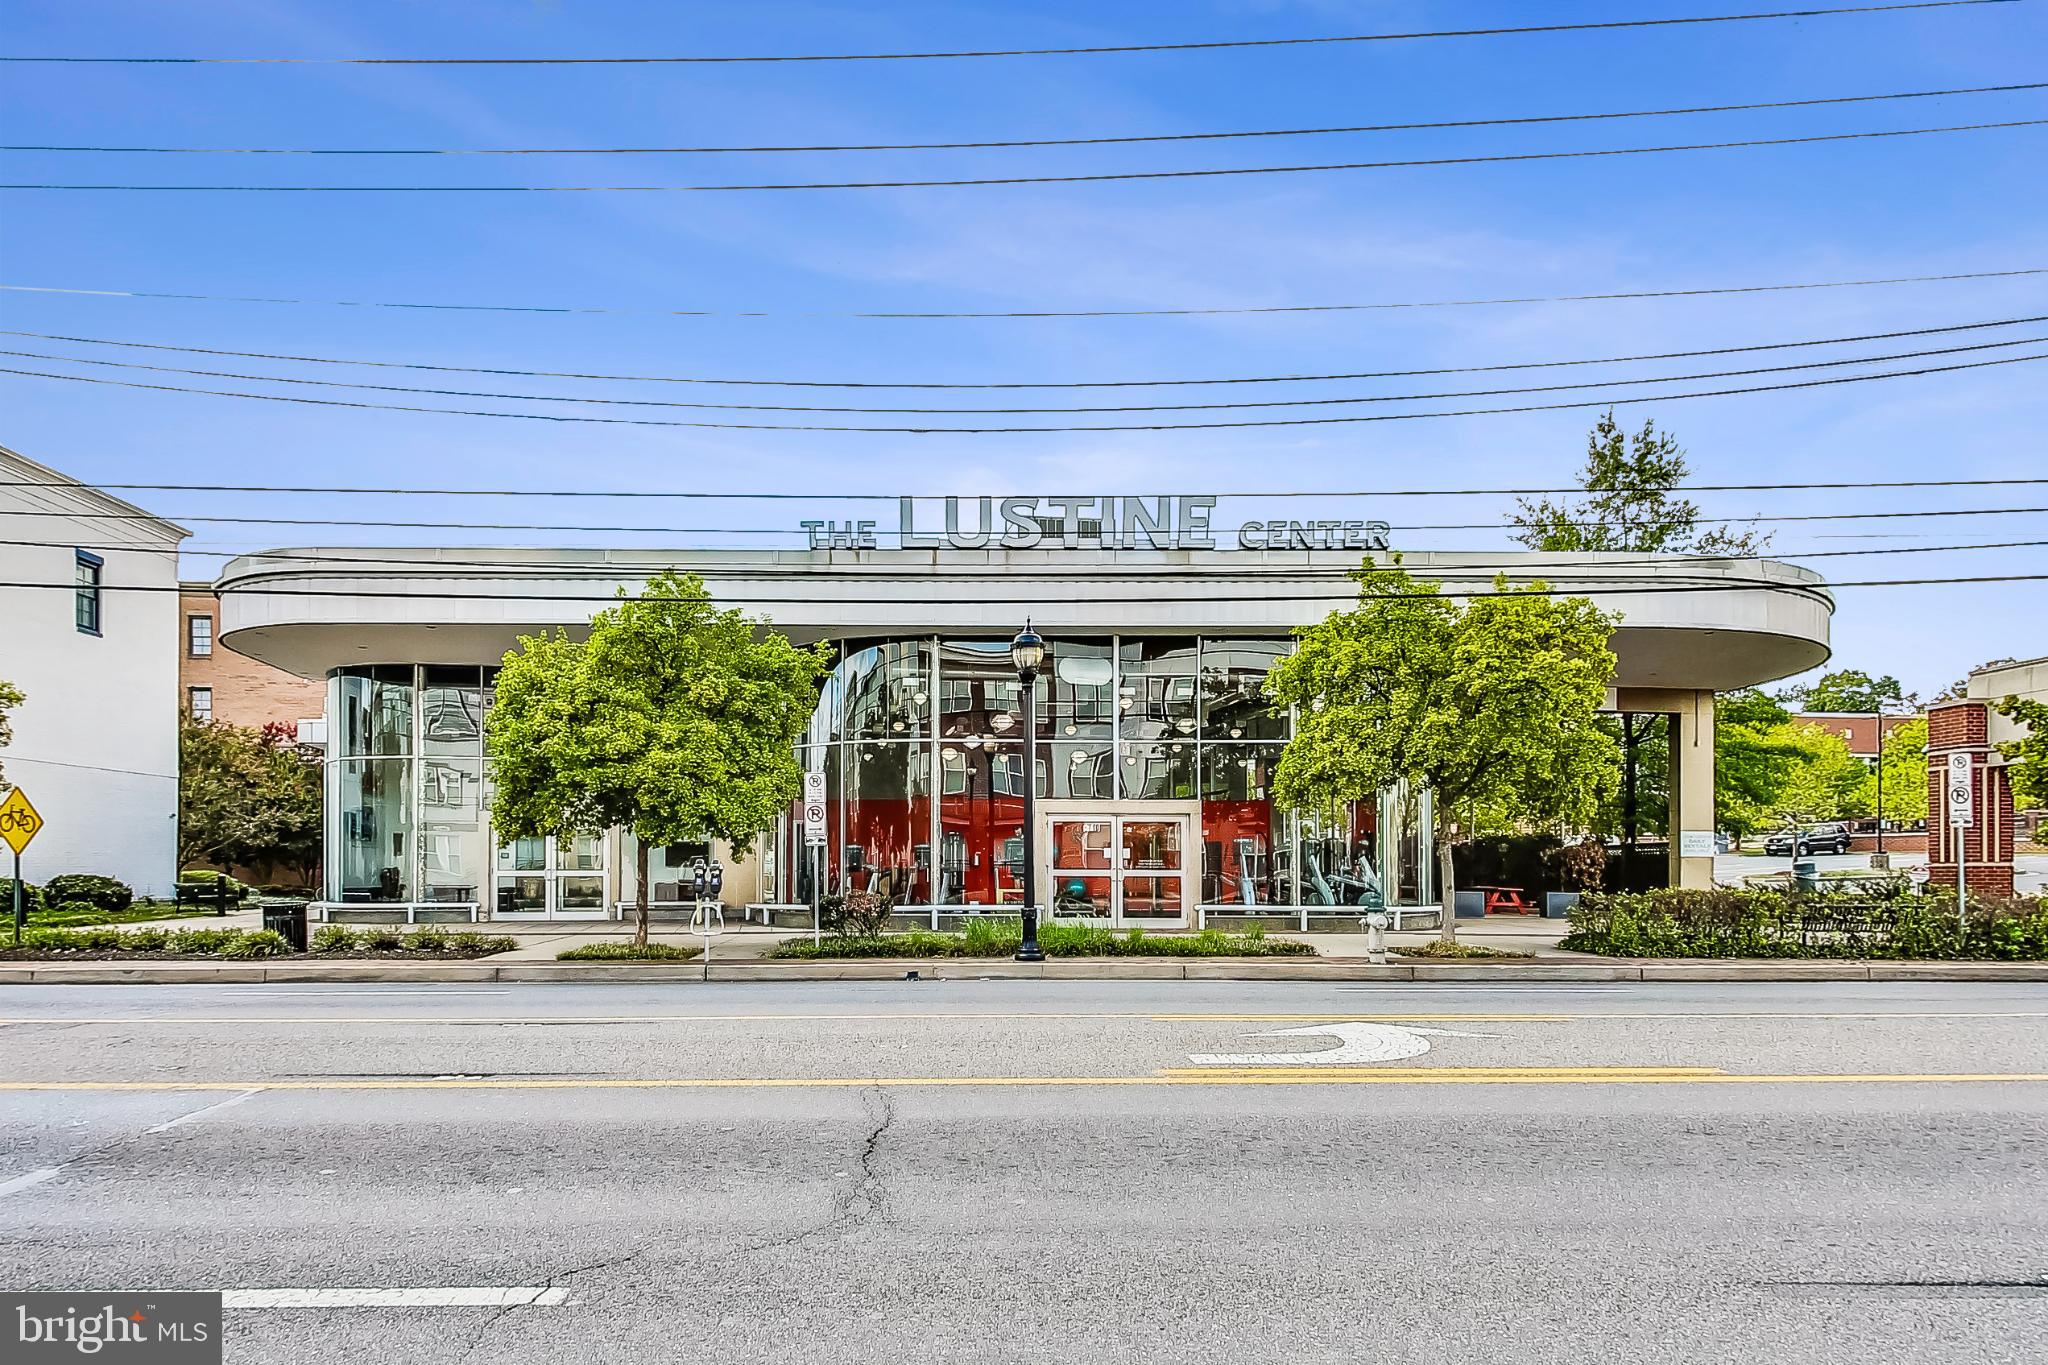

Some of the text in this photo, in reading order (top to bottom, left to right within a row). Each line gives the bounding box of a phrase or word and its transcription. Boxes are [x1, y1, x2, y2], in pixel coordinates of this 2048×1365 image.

[800, 496, 1391, 549] THE LUSTINE CENTER
